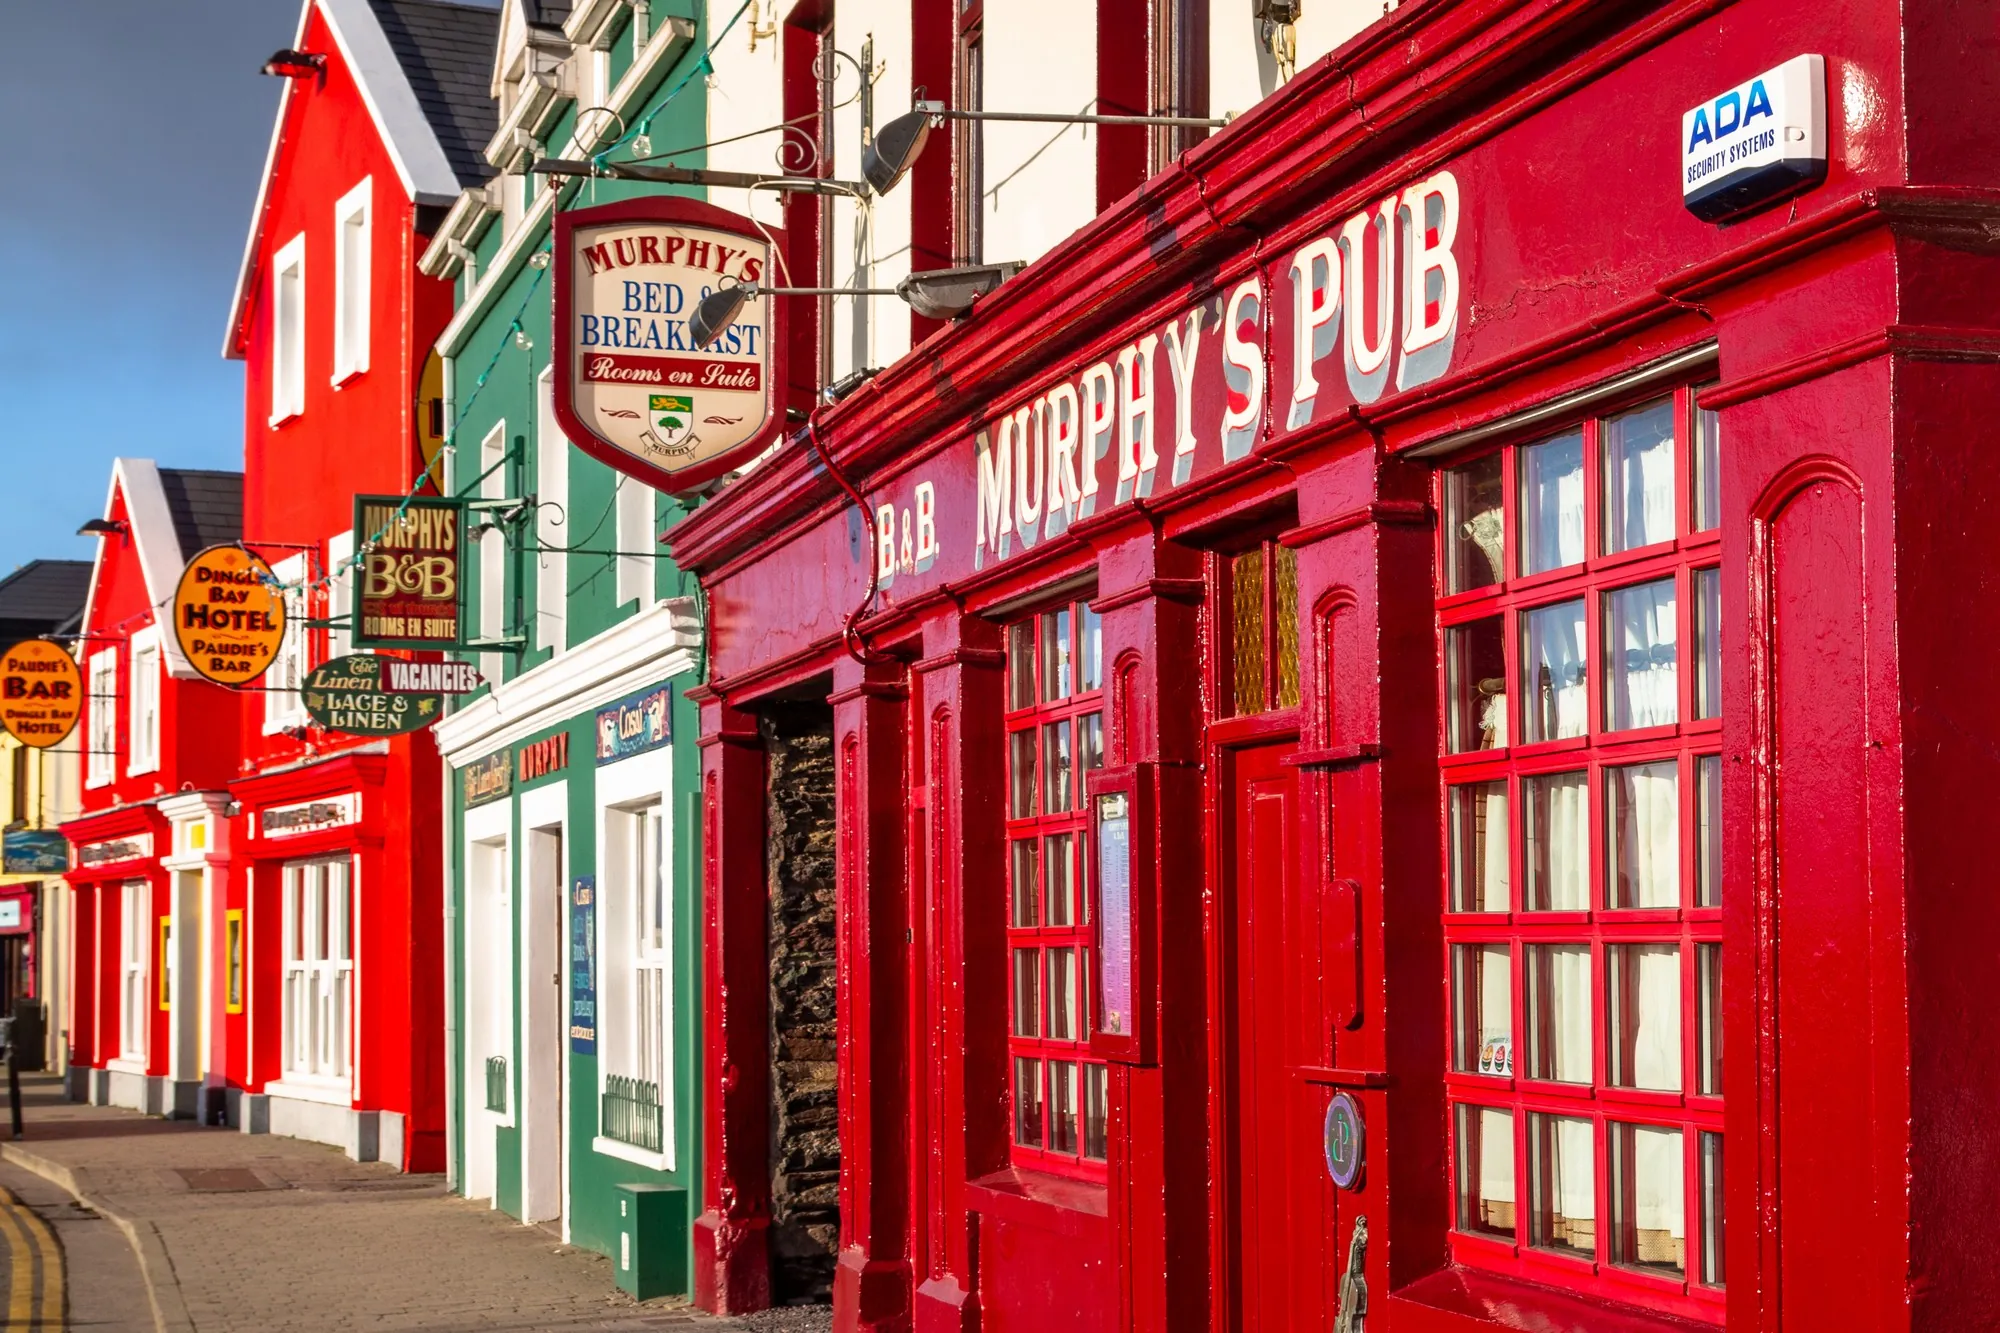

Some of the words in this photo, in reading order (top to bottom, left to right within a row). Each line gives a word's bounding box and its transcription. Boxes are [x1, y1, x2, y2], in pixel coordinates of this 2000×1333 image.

[1688, 79, 1773, 154] ADA
[1687, 150, 1726, 183] SECURITY
[1729, 129, 1775, 163] SYSTEMS
[582, 236, 764, 282] MURPHY'S
[623, 280, 683, 314] BED
[580, 315, 761, 355] BREAKST
[588, 357, 662, 382] Rooms
[668, 371, 693, 384] en
[700, 363, 756, 388] Suite
[975, 277, 1264, 555] MURPHY'S
[1290, 170, 1459, 405] PUB
[652, 443, 690, 455] MURPHY
[195, 567, 265, 586] DINGL
[364, 554, 455, 600] B&B
[209, 586, 249, 604] BAY
[182, 603, 277, 632] HOTEL
[364, 616, 405, 637] ROOMS
[408, 618, 421, 637] EN
[424, 618, 456, 638] SUITE
[192, 639, 268, 657] PAUDIE'S
[8, 658, 67, 672] PAUDIE'S
[210, 658, 251, 673] BAR
[347, 657, 378, 675] The
[4, 677, 72, 699] BAR
[313, 670, 372, 690] Linen
[390, 663, 477, 691] VACANCIES
[328, 694, 387, 711] LACE
[392, 696, 408, 713] &
[17, 721, 63, 733] HOTEL
[331, 712, 402, 729] LINEN
